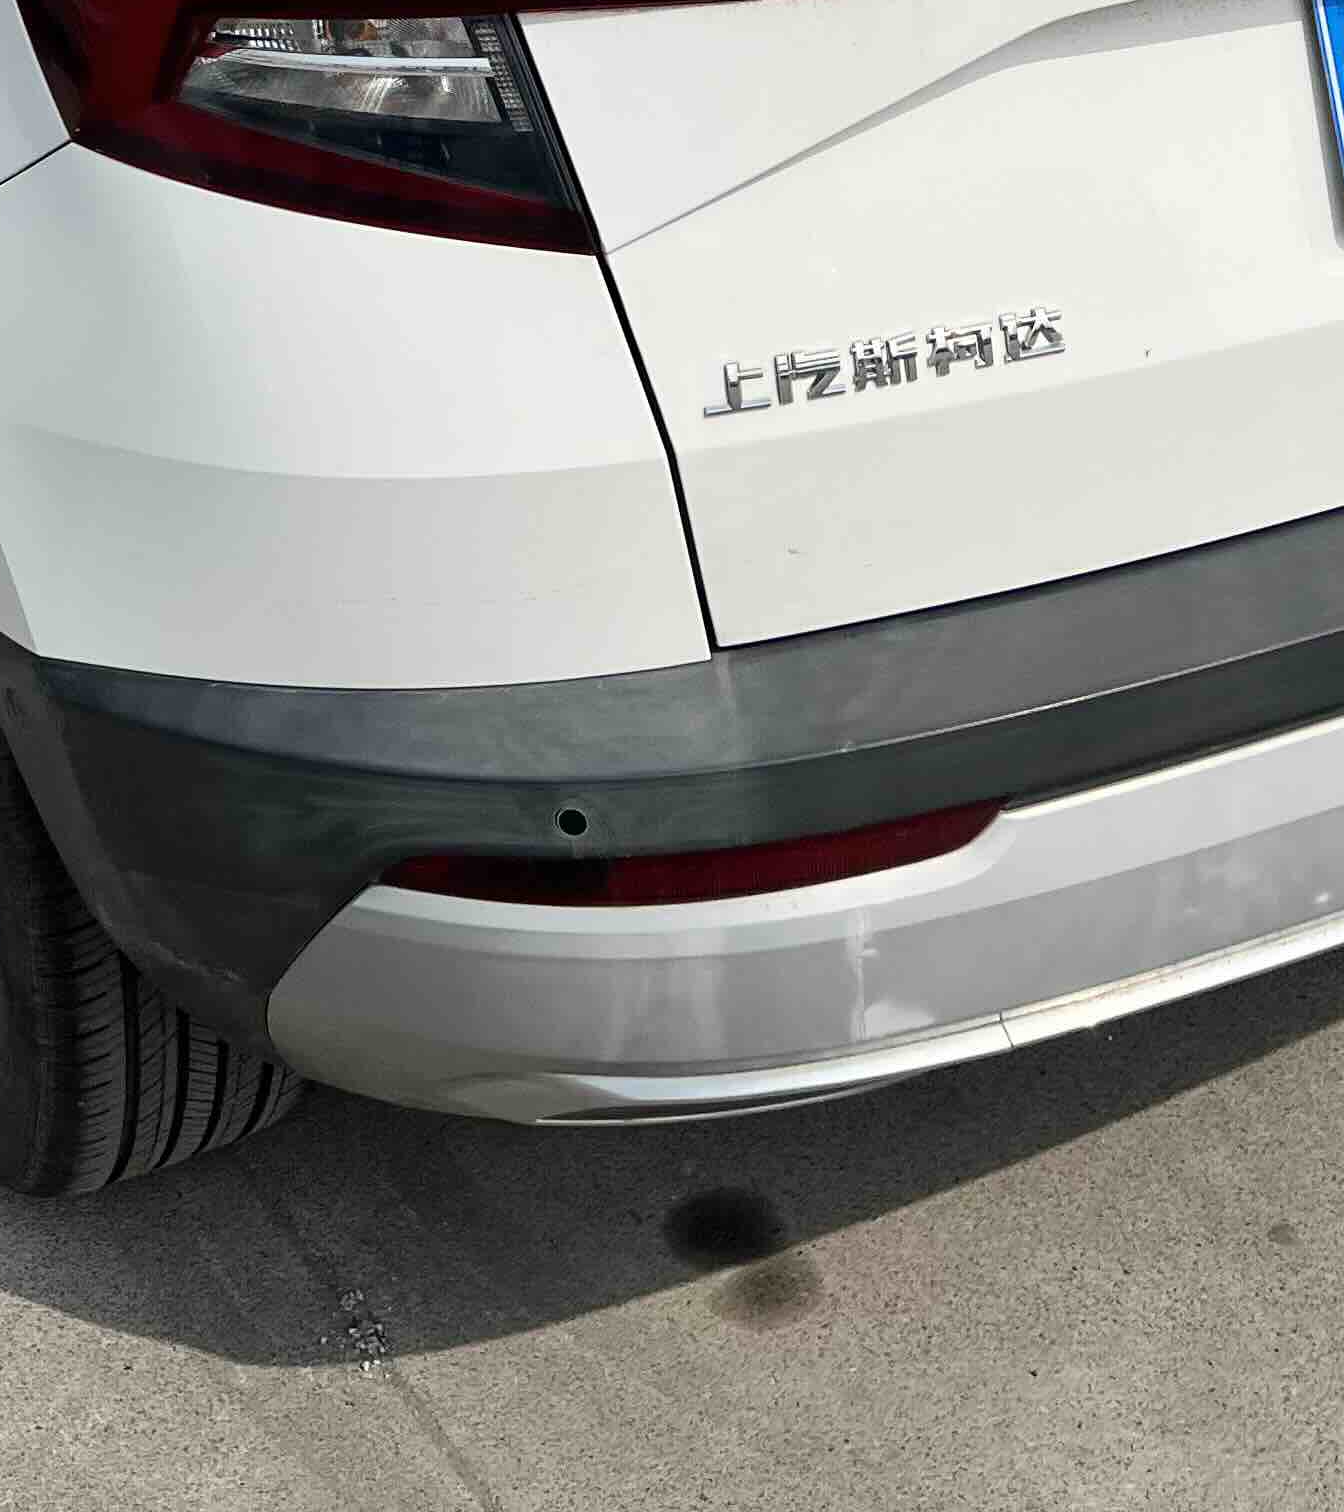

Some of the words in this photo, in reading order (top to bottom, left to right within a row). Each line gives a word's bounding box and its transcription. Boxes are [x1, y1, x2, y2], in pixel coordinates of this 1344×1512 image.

[702, 306, 1066, 419] 上汽斯柯达
